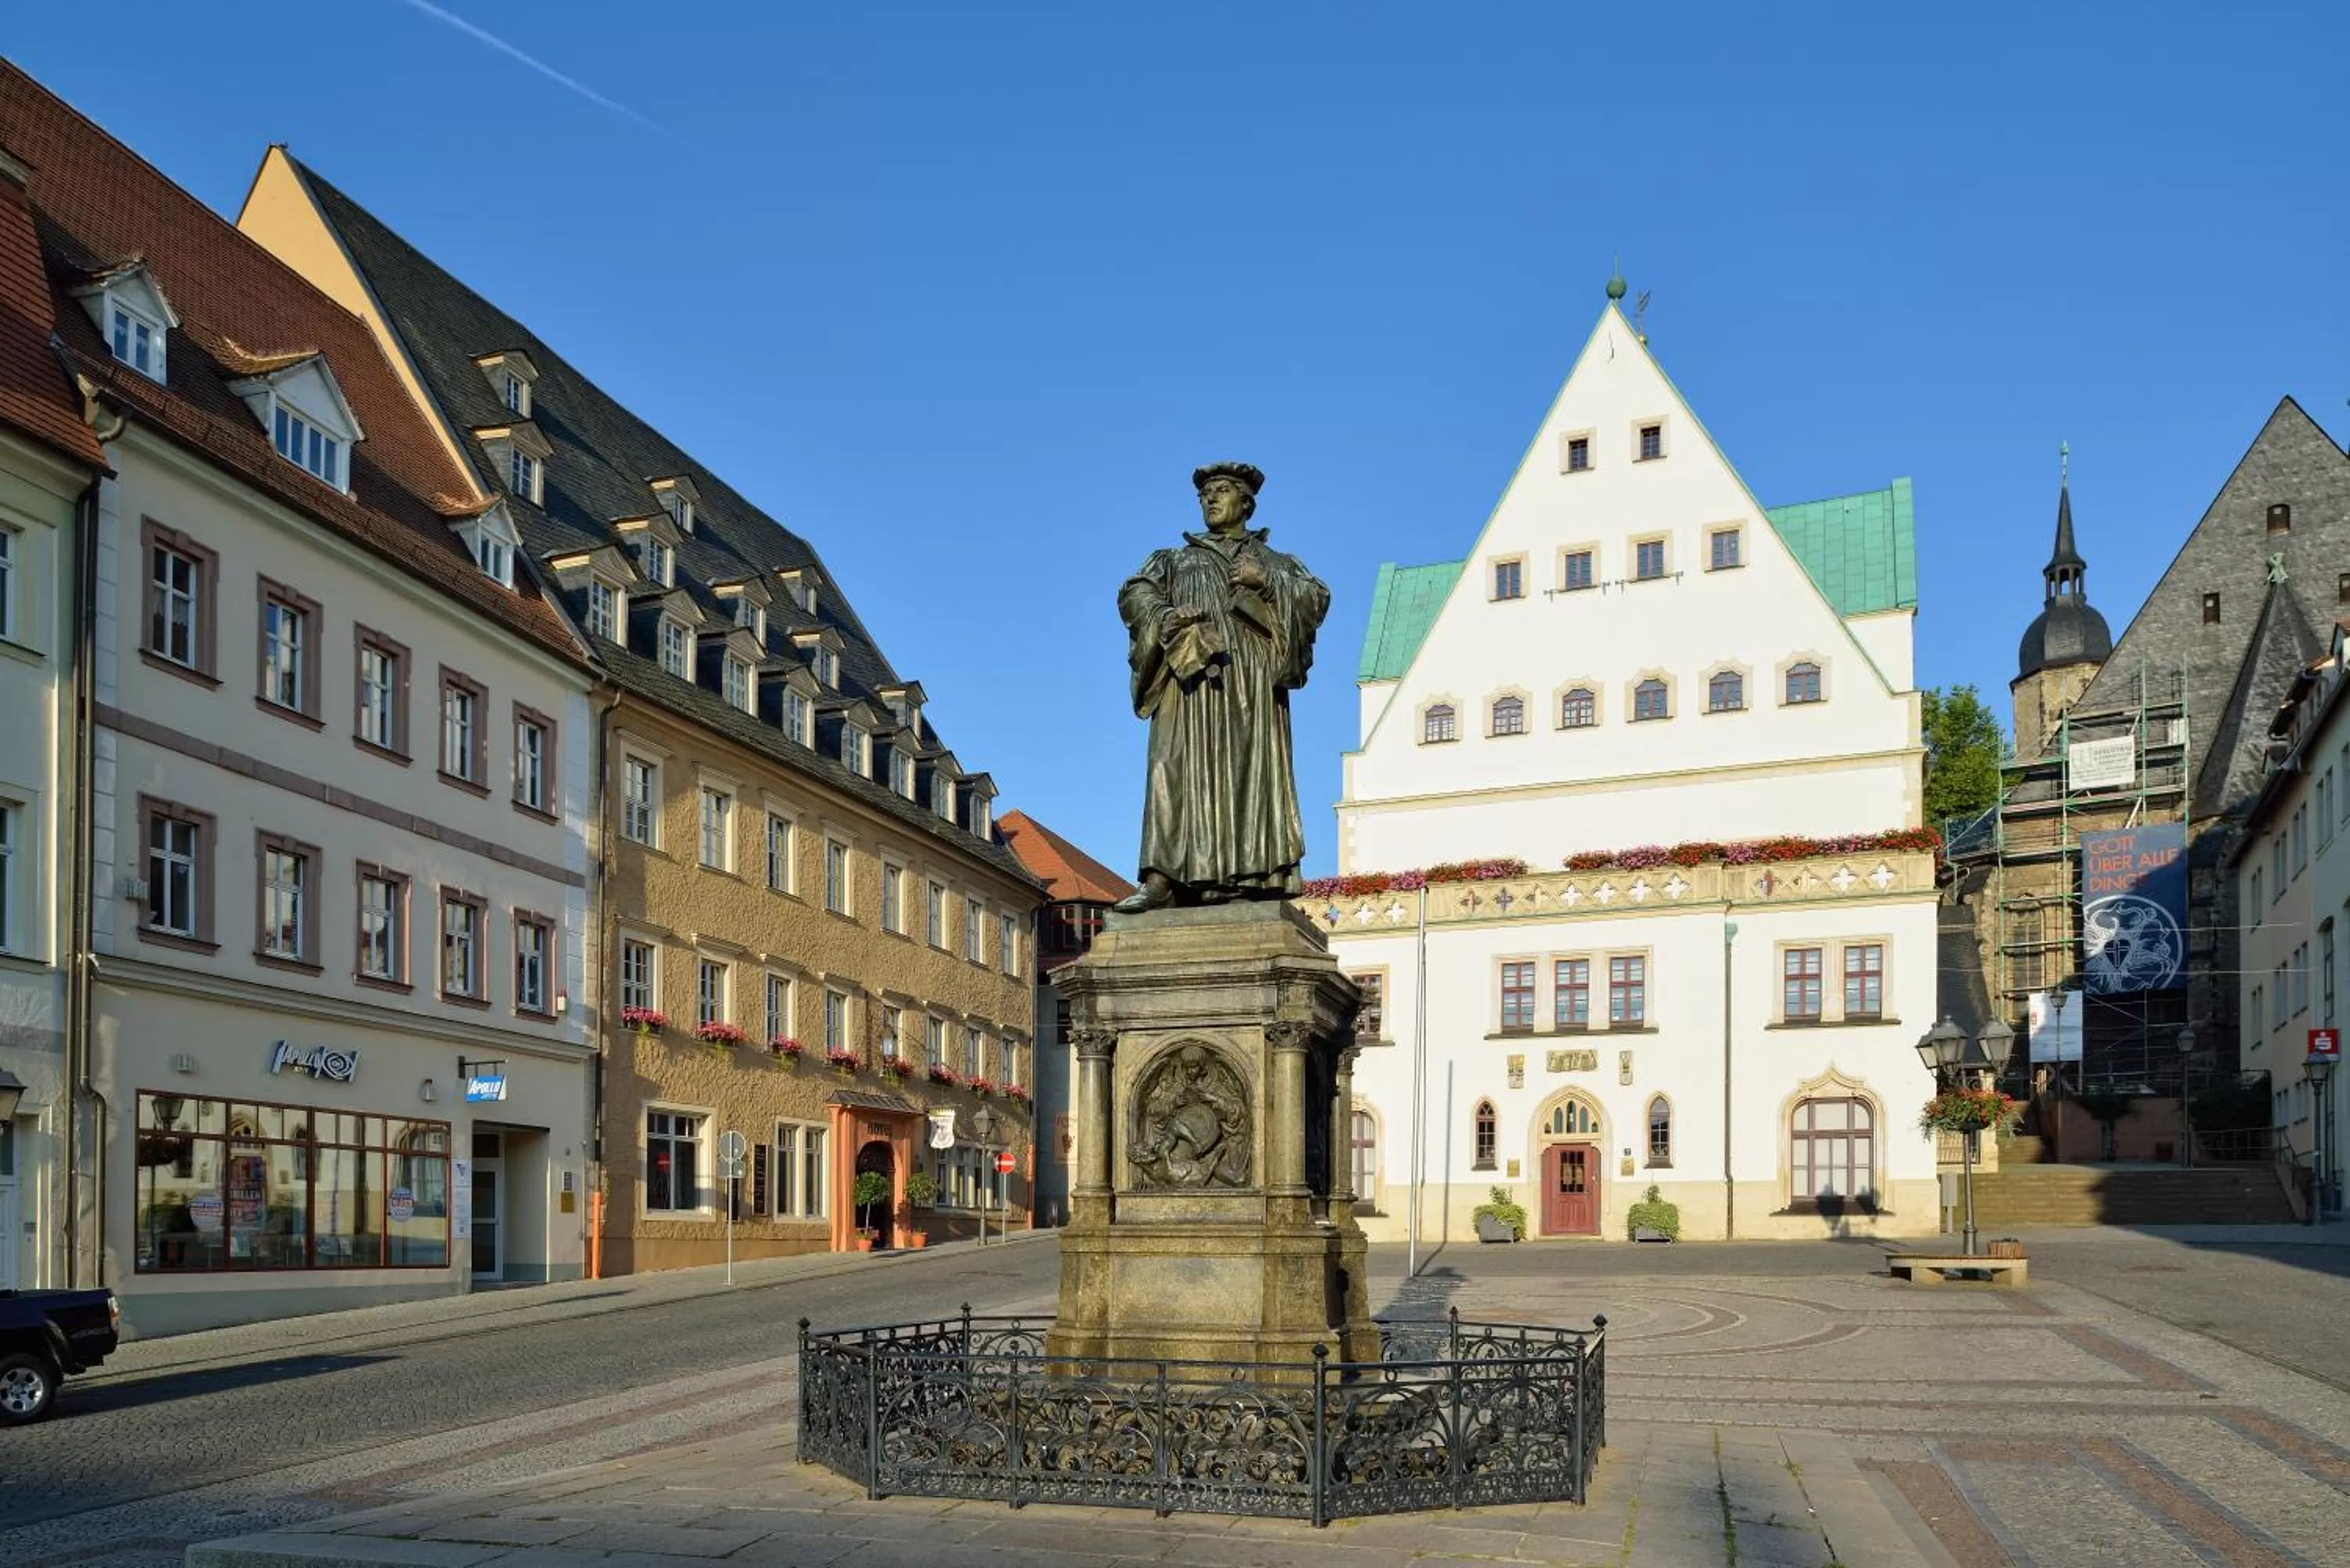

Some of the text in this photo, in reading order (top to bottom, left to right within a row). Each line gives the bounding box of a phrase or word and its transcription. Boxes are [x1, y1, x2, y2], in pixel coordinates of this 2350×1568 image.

[2088, 835, 2135, 854] GOTT
[2140, 847, 2180, 866] ALLE
[468, 1080, 501, 1094] APOLLO
